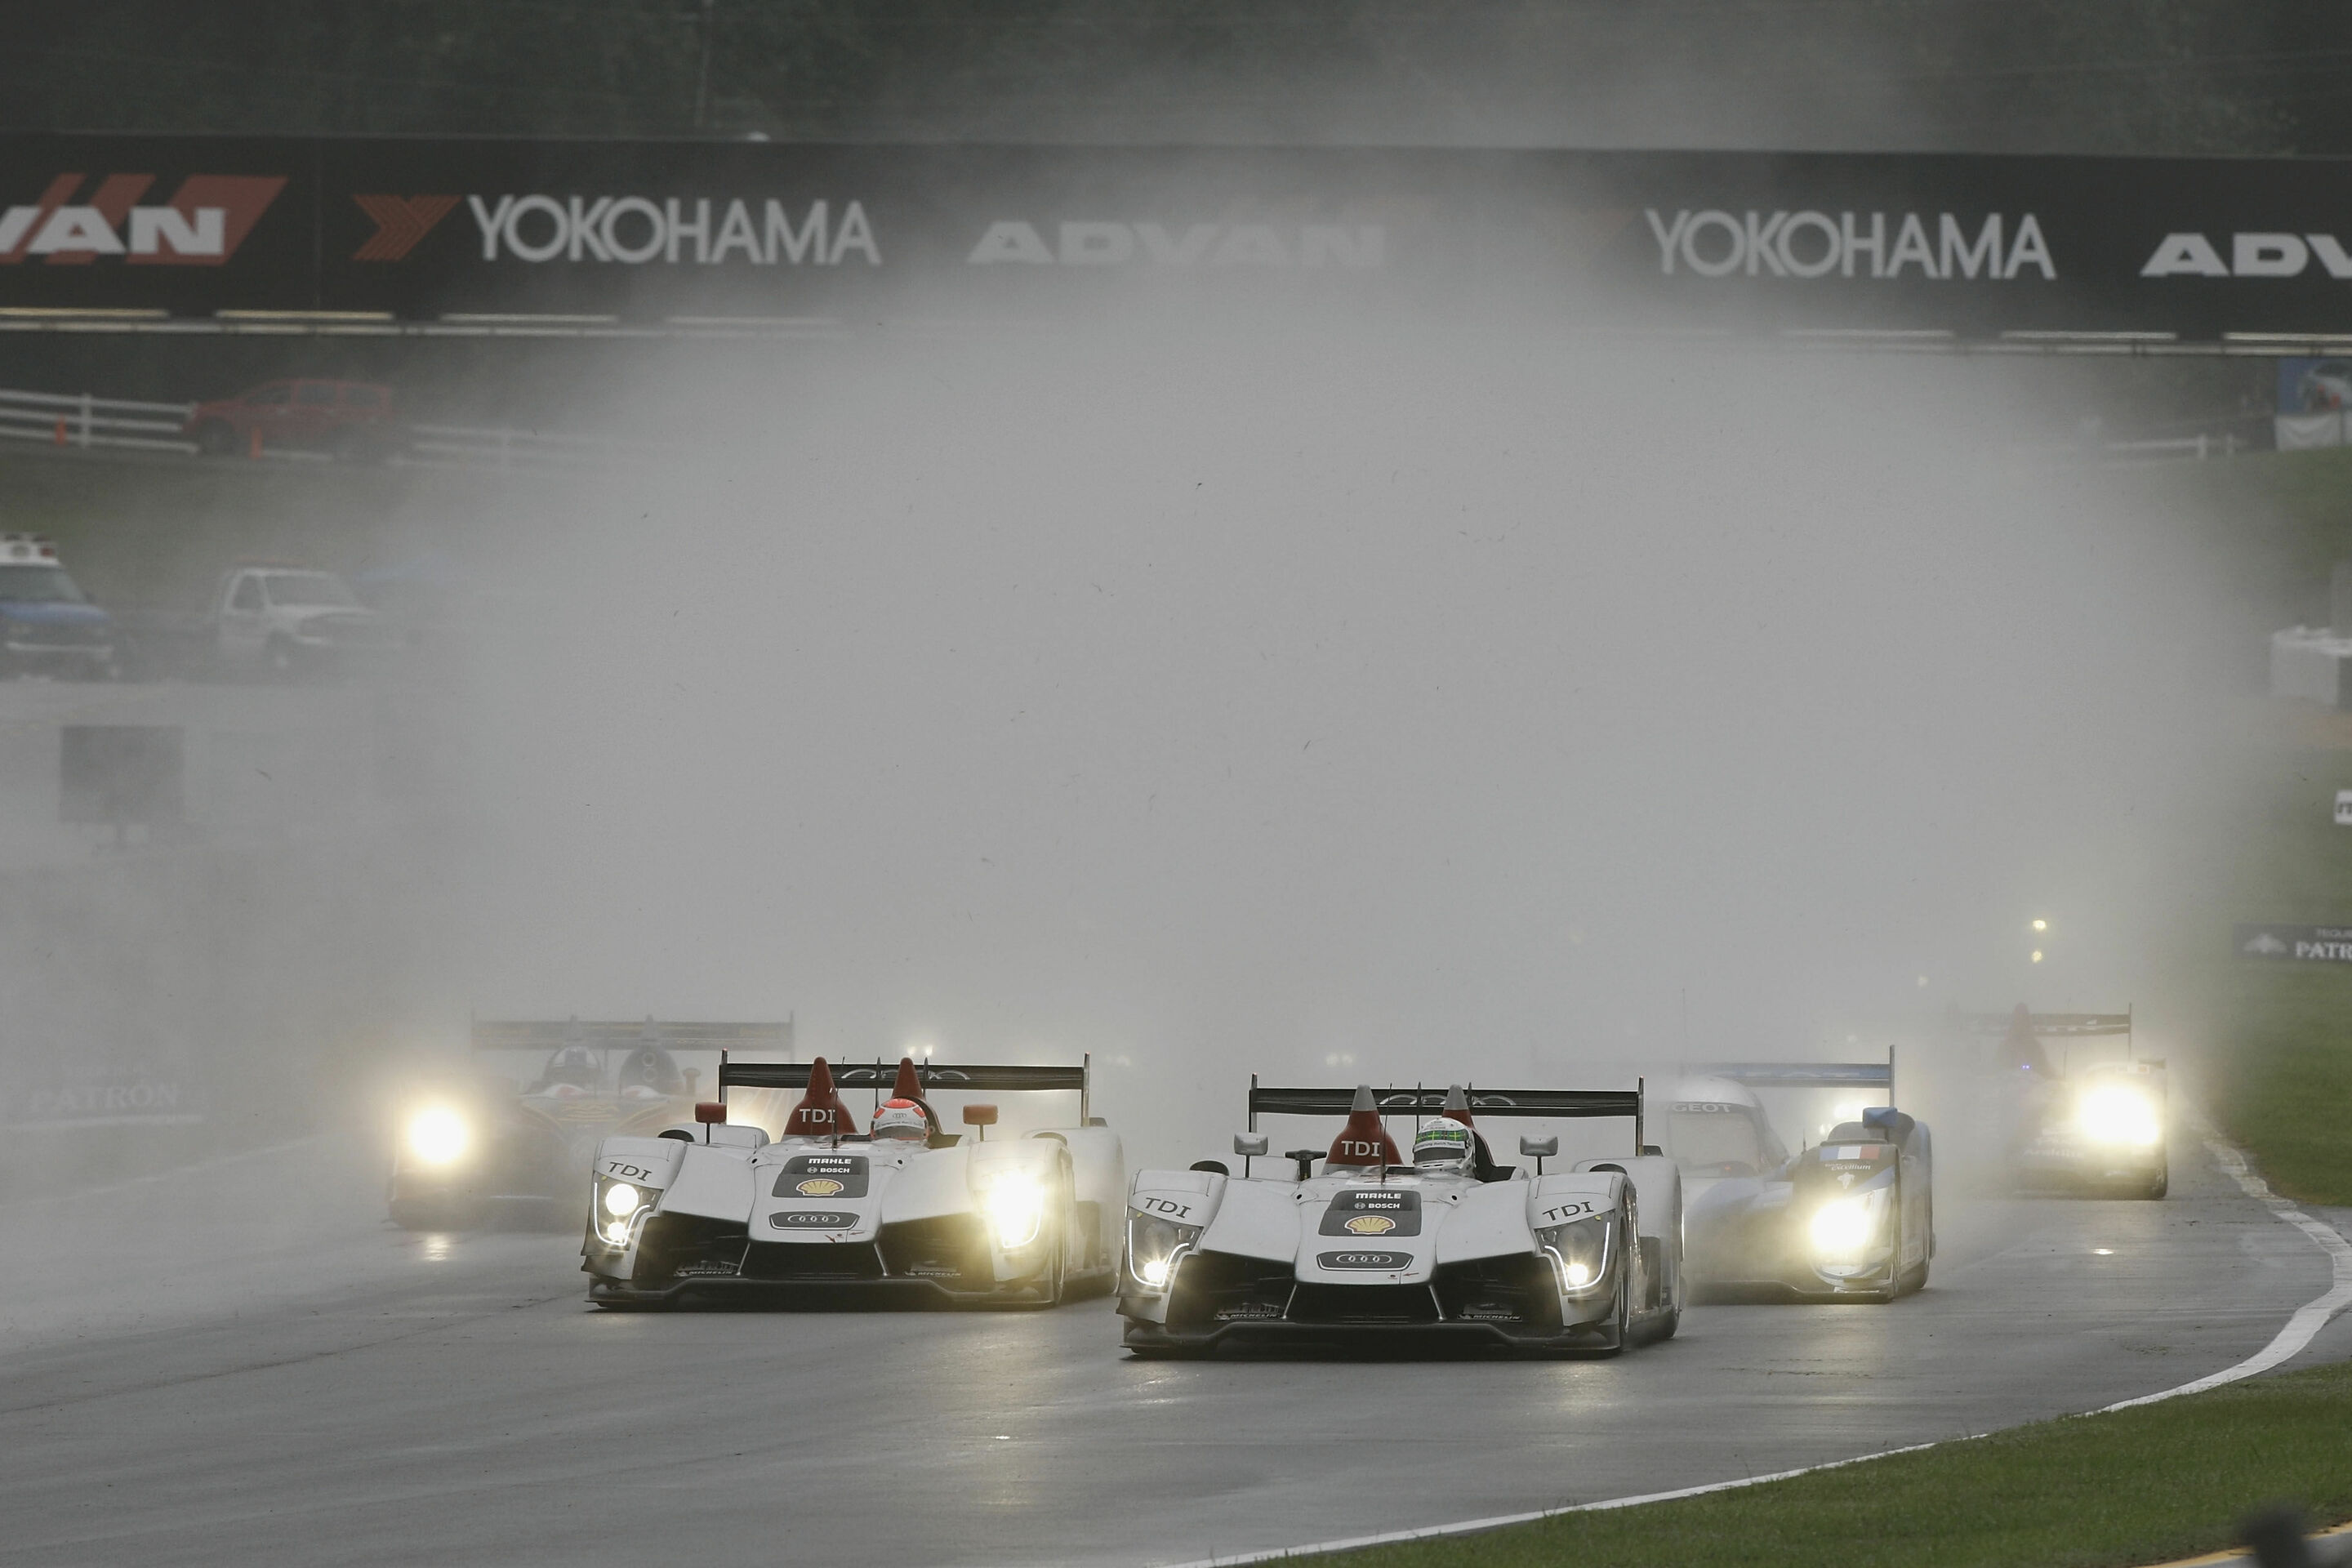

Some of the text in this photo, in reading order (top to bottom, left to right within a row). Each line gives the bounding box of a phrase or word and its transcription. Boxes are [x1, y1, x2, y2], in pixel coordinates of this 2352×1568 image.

[467, 194, 883, 266] YOKOHAMA
[966, 220, 1388, 268] ADVAN
[1645, 208, 2057, 280] YOKOHAMA
[2139, 232, 2352, 278] ADV
[799, 1108, 835, 1123] TDI
[1341, 1140, 1380, 1156] TDI
[609, 1161, 653, 1182] TDI
[1145, 1197, 1192, 1218] TDI
[1542, 1201, 1594, 1221] TDI
